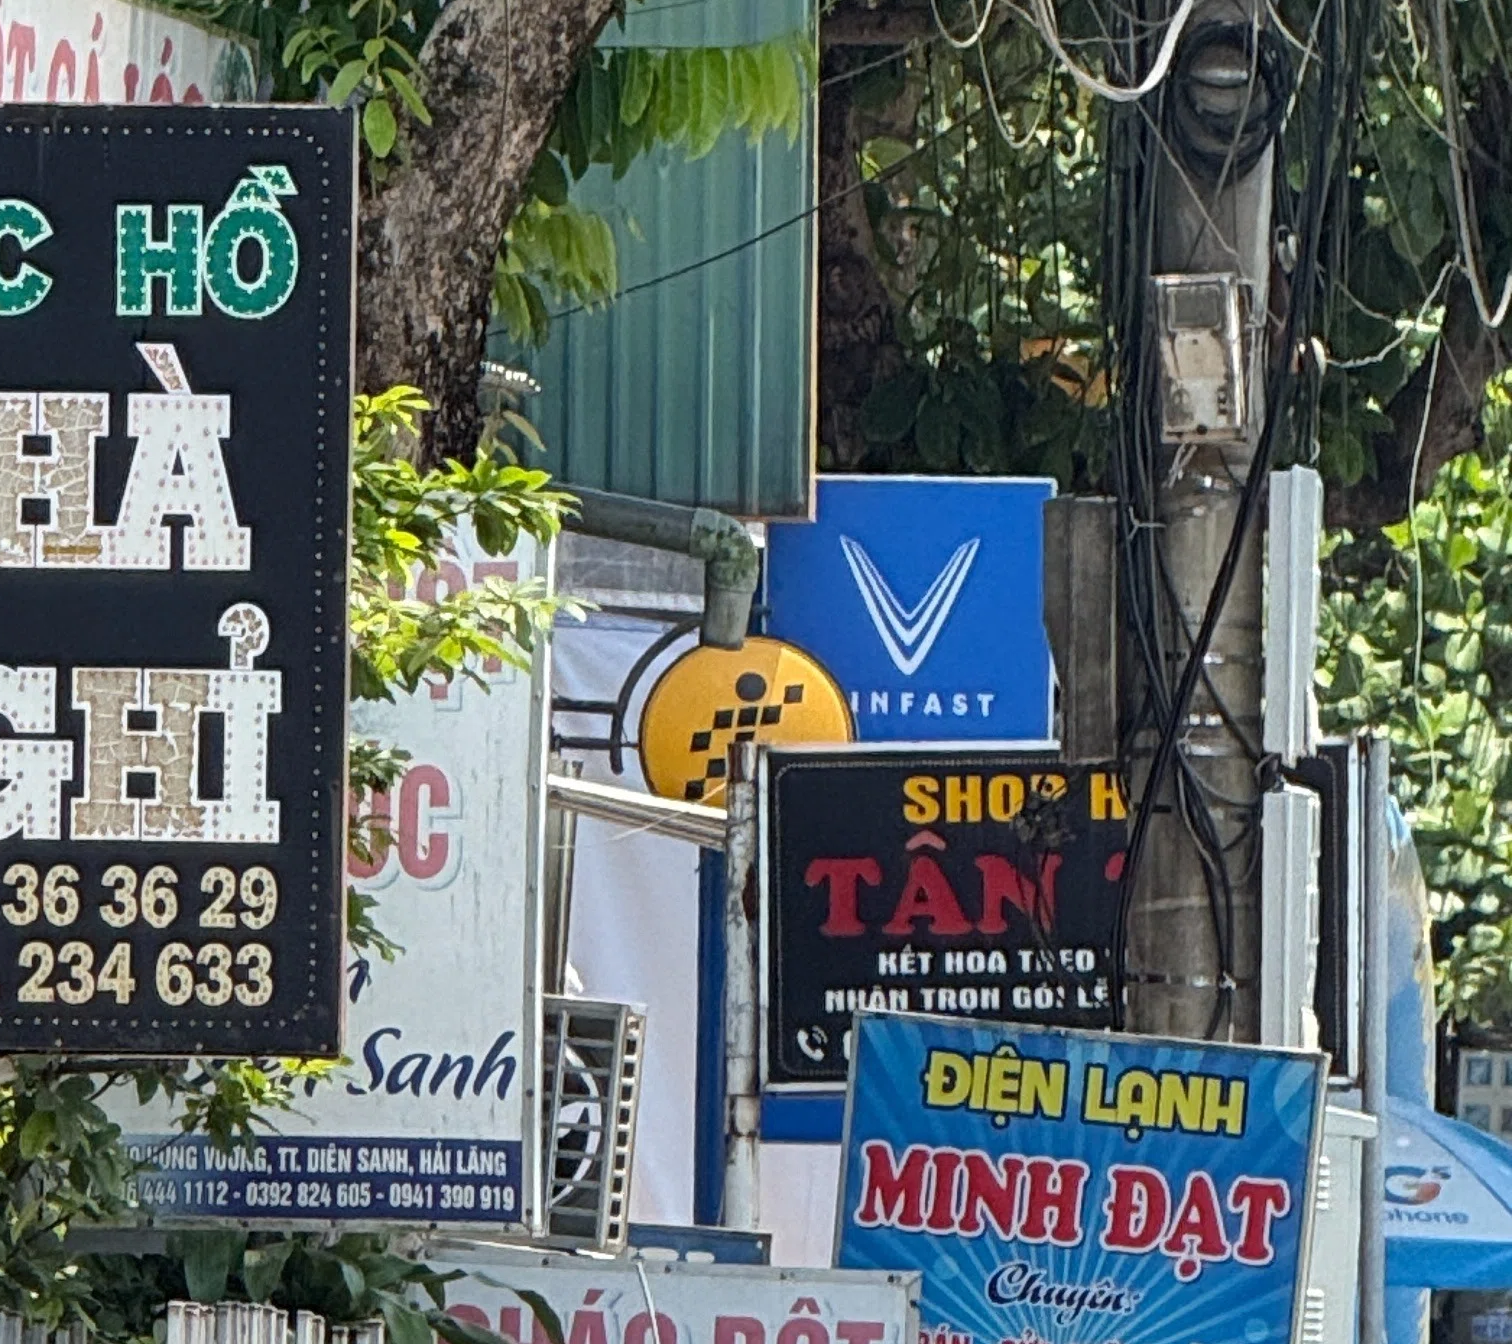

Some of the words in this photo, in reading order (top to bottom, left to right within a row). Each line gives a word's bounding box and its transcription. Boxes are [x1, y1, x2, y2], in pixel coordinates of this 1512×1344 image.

[116, 166, 299, 318] HỒ
[851, 691, 995, 717] INFAST
[2, 864, 79, 927] 36
[100, 865, 178, 928] 36
[199, 866, 278, 929] 29
[805, 830, 1063, 936] TÂN
[17, 941, 136, 1005] 234
[155, 942, 273, 1007] 633
[945, 950, 1007, 975] HOA
[347, 1028, 516, 1100] Sanh
[924, 1043, 1065, 1127] ĐIỆN
[1084, 1066, 1246, 1139] LẠNH
[357, 1147, 414, 1176] SANH,
[419, 1141, 451, 1175] HẢI
[456, 1145, 506, 1177] LĂNG
[246, 1181, 292, 1207] 0392
[297, 1182, 331, 1207] 824
[337, 1182, 371, 1207] 605
[389, 1183, 433, 1209] 0941
[480, 1186, 515, 1211] 919
[854, 1140, 1089, 1247] MINH
[1100, 1164, 1289, 1281] ĐẠT
